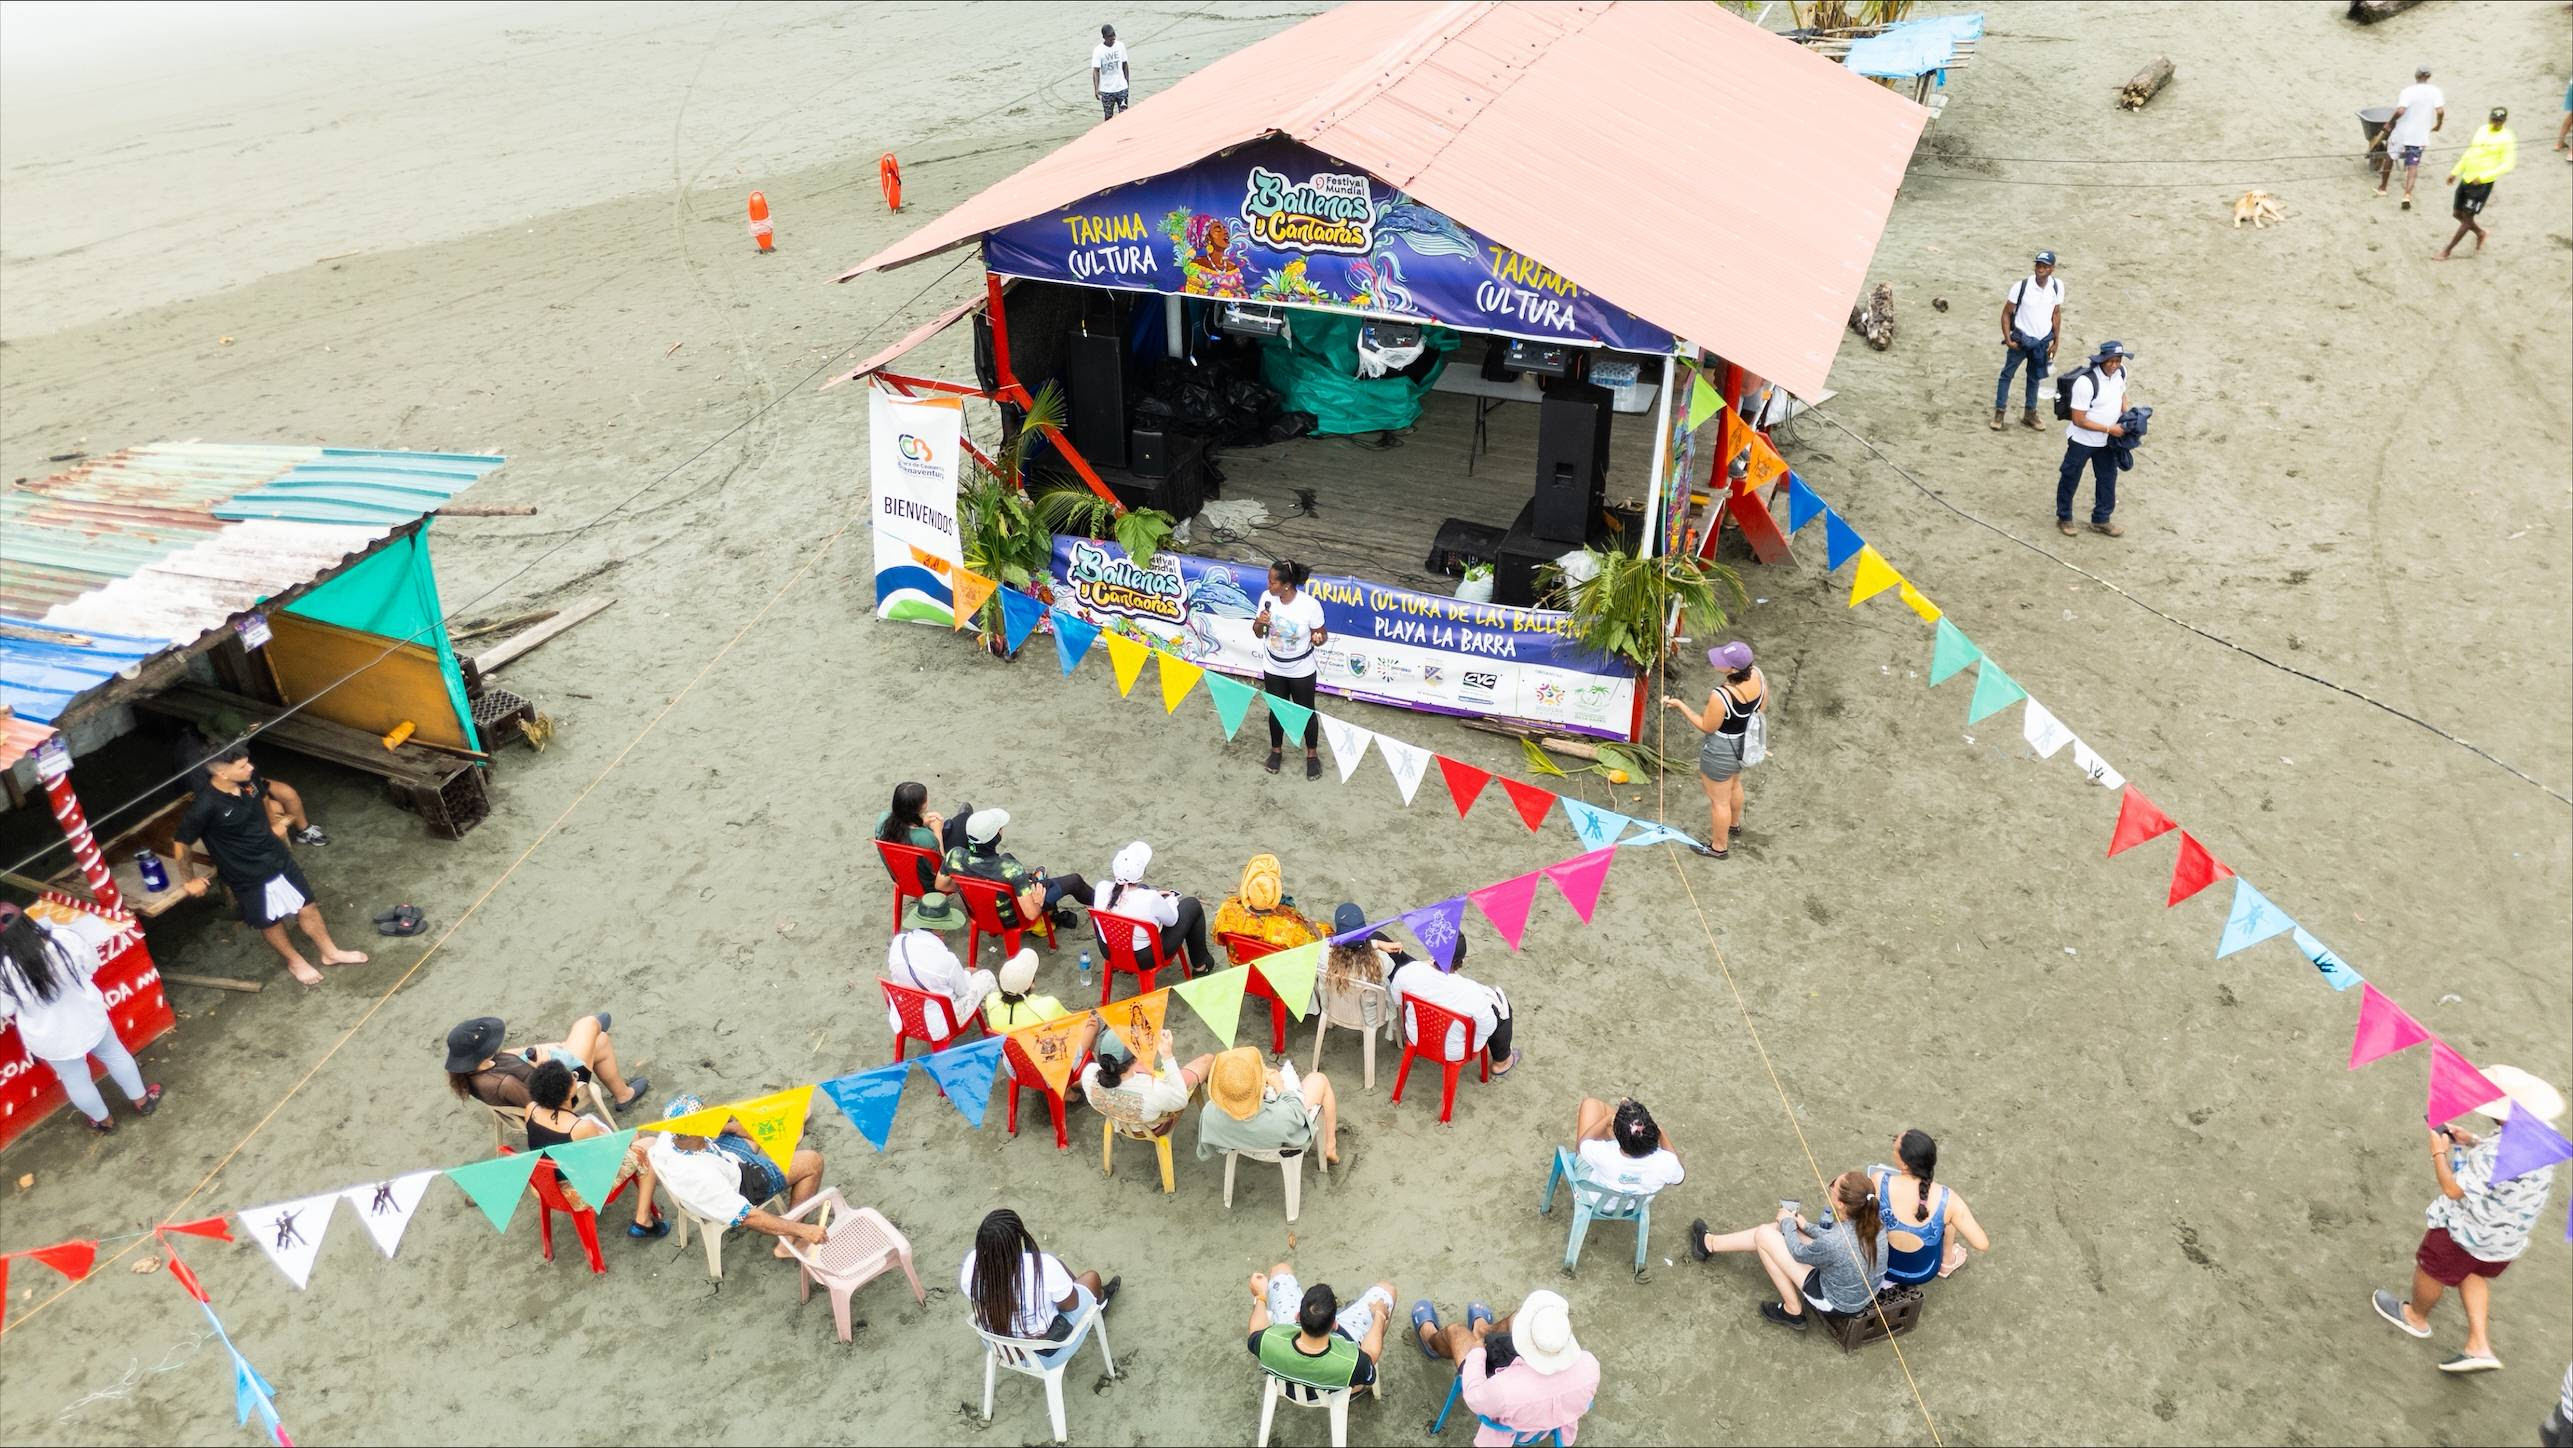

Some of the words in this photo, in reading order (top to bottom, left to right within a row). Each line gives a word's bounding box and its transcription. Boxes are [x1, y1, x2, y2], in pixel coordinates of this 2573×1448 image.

[1247, 170, 1369, 221] Ballenas
[1326, 176, 1364, 188] Festival
[1326, 186, 1365, 196] Mundial
[1062, 212, 1149, 246] TARIMA
[1255, 218, 1266, 236] y
[1267, 211, 1366, 245] Cantaoras
[1068, 245, 1158, 280] CULTURA
[1488, 246, 1577, 298] TARIMA
[1476, 280, 1575, 332] CULTURA
[884, 496, 953, 536] BIENVENIDOS
[1070, 543, 1182, 595] Ballenas
[1080, 583, 1090, 598] y
[1091, 581, 1181, 616] Cantaoras
[1305, 577, 1364, 607] TARIMA
[1369, 589, 1442, 619] CULTURA
[1448, 603, 1471, 623] DE
[1475, 606, 1507, 630] LAS
[1375, 616, 1426, 643] PLAYA
[1432, 625, 1454, 648] LA
[1460, 628, 1517, 658] BARRA
[1464, 673, 1497, 686] CVC
